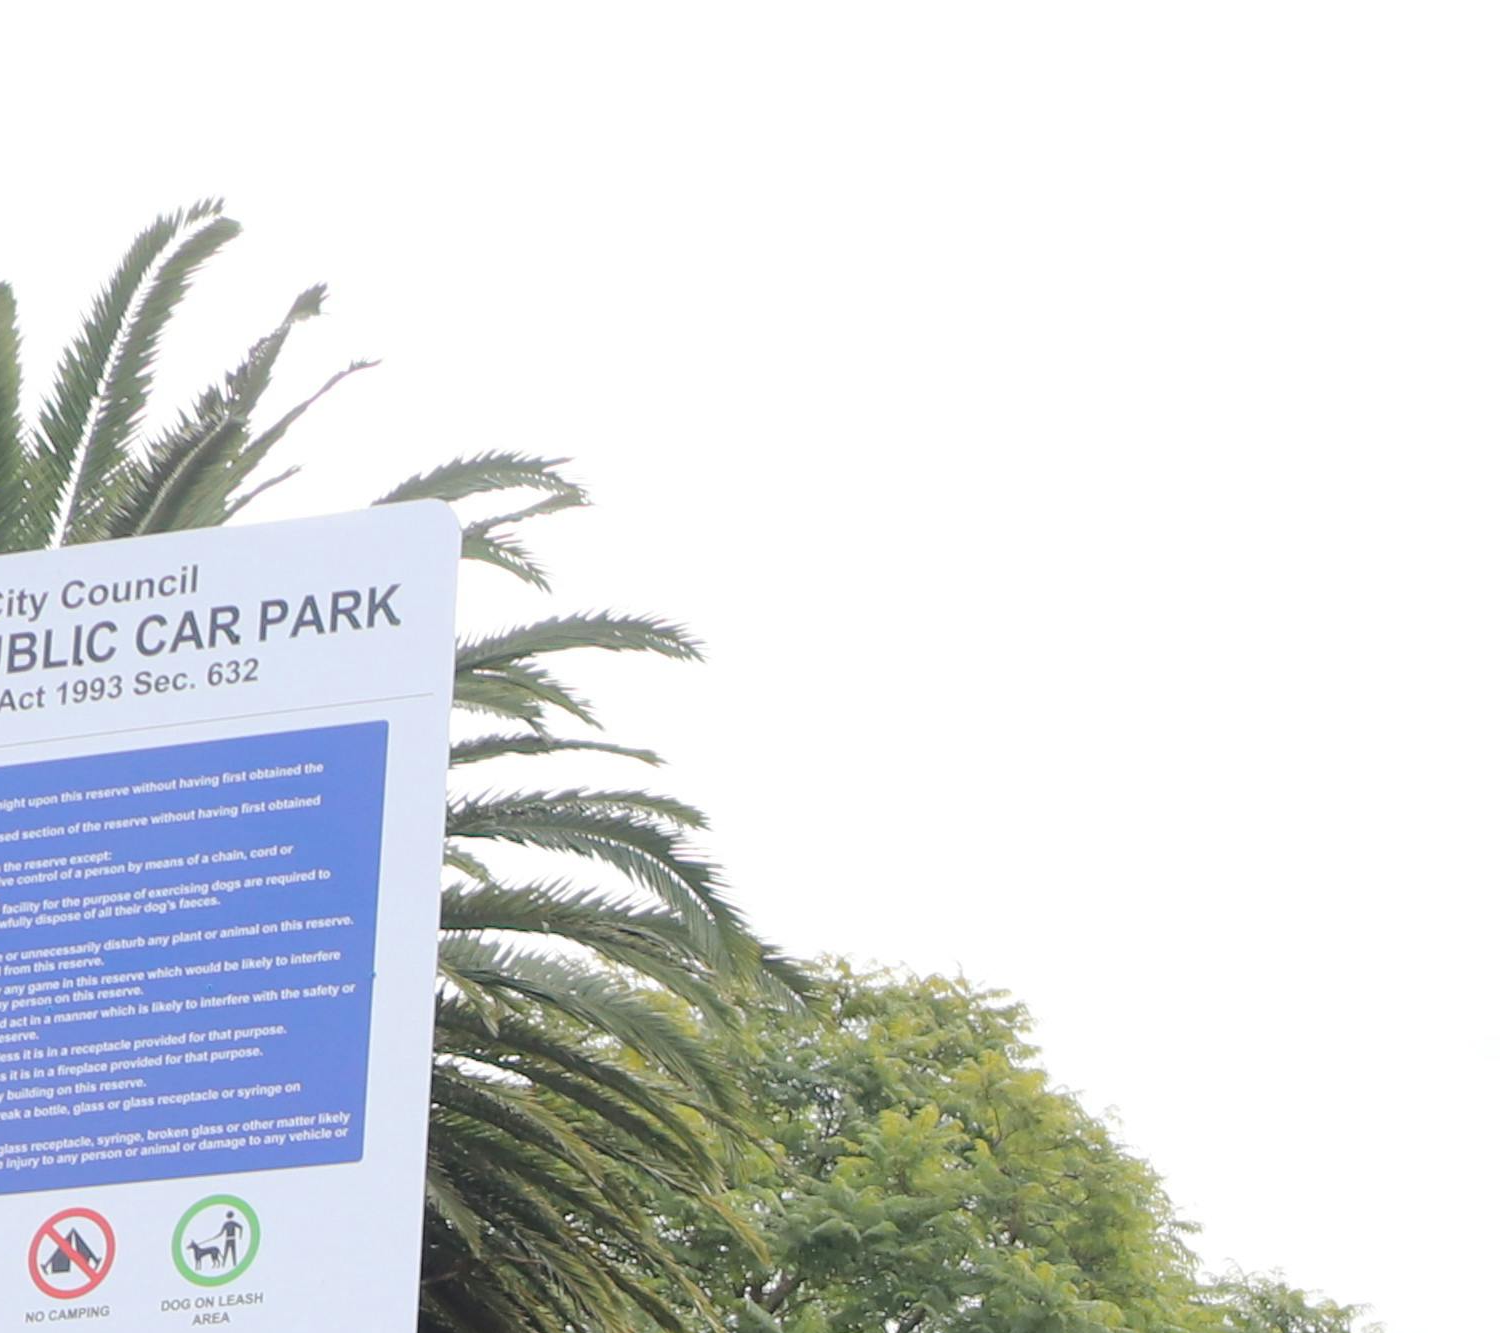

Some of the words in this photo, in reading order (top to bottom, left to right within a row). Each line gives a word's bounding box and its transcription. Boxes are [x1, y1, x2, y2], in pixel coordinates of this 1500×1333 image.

[60, 564, 198, 609] Council
[135, 604, 241, 657] CAR
[258, 583, 401, 642] PARK
[56, 674, 123, 705] 1993
[133, 670, 195, 696] Sec.
[206, 657, 259, 686] 632
[27, 794, 59, 808] upon
[60, 790, 83, 803] this
[84, 786, 130, 800] reserve
[131, 779, 177, 794] without
[178, 775, 220, 789] having
[221, 770, 247, 784] first
[247, 763, 302, 781] obtained
[303, 762, 324, 774] the
[20, 825, 65, 840] section
[66, 821, 81, 834] of
[81, 820, 102, 833] the
[103, 816, 149, 830] reserve
[149, 809, 196, 824] without
[197, 805, 239, 819] having
[240, 801, 266, 814] first
[267, 793, 321, 811] obtained
[2, 860, 23, 873] the
[23, 856, 68, 870] reserve
[4, 951, 19, 962] or
[19, 940, 102, 960] unnecessarily
[102, 935, 146, 951] disturb
[146, 935, 170, 947] any
[171, 929, 202, 946] plant
[203, 929, 218, 940] or
[219, 923, 260, 938] animal
[261, 923, 278, 934] on
[279, 919, 303, 932] this
[22, 1048, 32, 1060] it
[32, 1047, 45, 1059] is
[45, 1046, 58, 1058] in
[59, 1046, 69, 1056] a
[69, 1039, 132, 1055] receptacle
[132, 1032, 187, 1051] provided
[187, 1031, 207, 1043] for
[207, 1028, 232, 1041] that
[146, 1126, 189, 1141] broken
[190, 1123, 224, 1139] glass
[225, 1122, 240, 1133] or
[241, 1118, 275, 1131] other
[275, 1115, 316, 1128] matter
[317, 1110, 351, 1125] likely
[24, 1310, 45, 1323] NO
[47, 1305, 110, 1321] CAMPING
[160, 1297, 191, 1312] DOG
[194, 1296, 215, 1309] ON
[217, 1291, 264, 1307] LEASH
[191, 1311, 230, 1325] AREA
